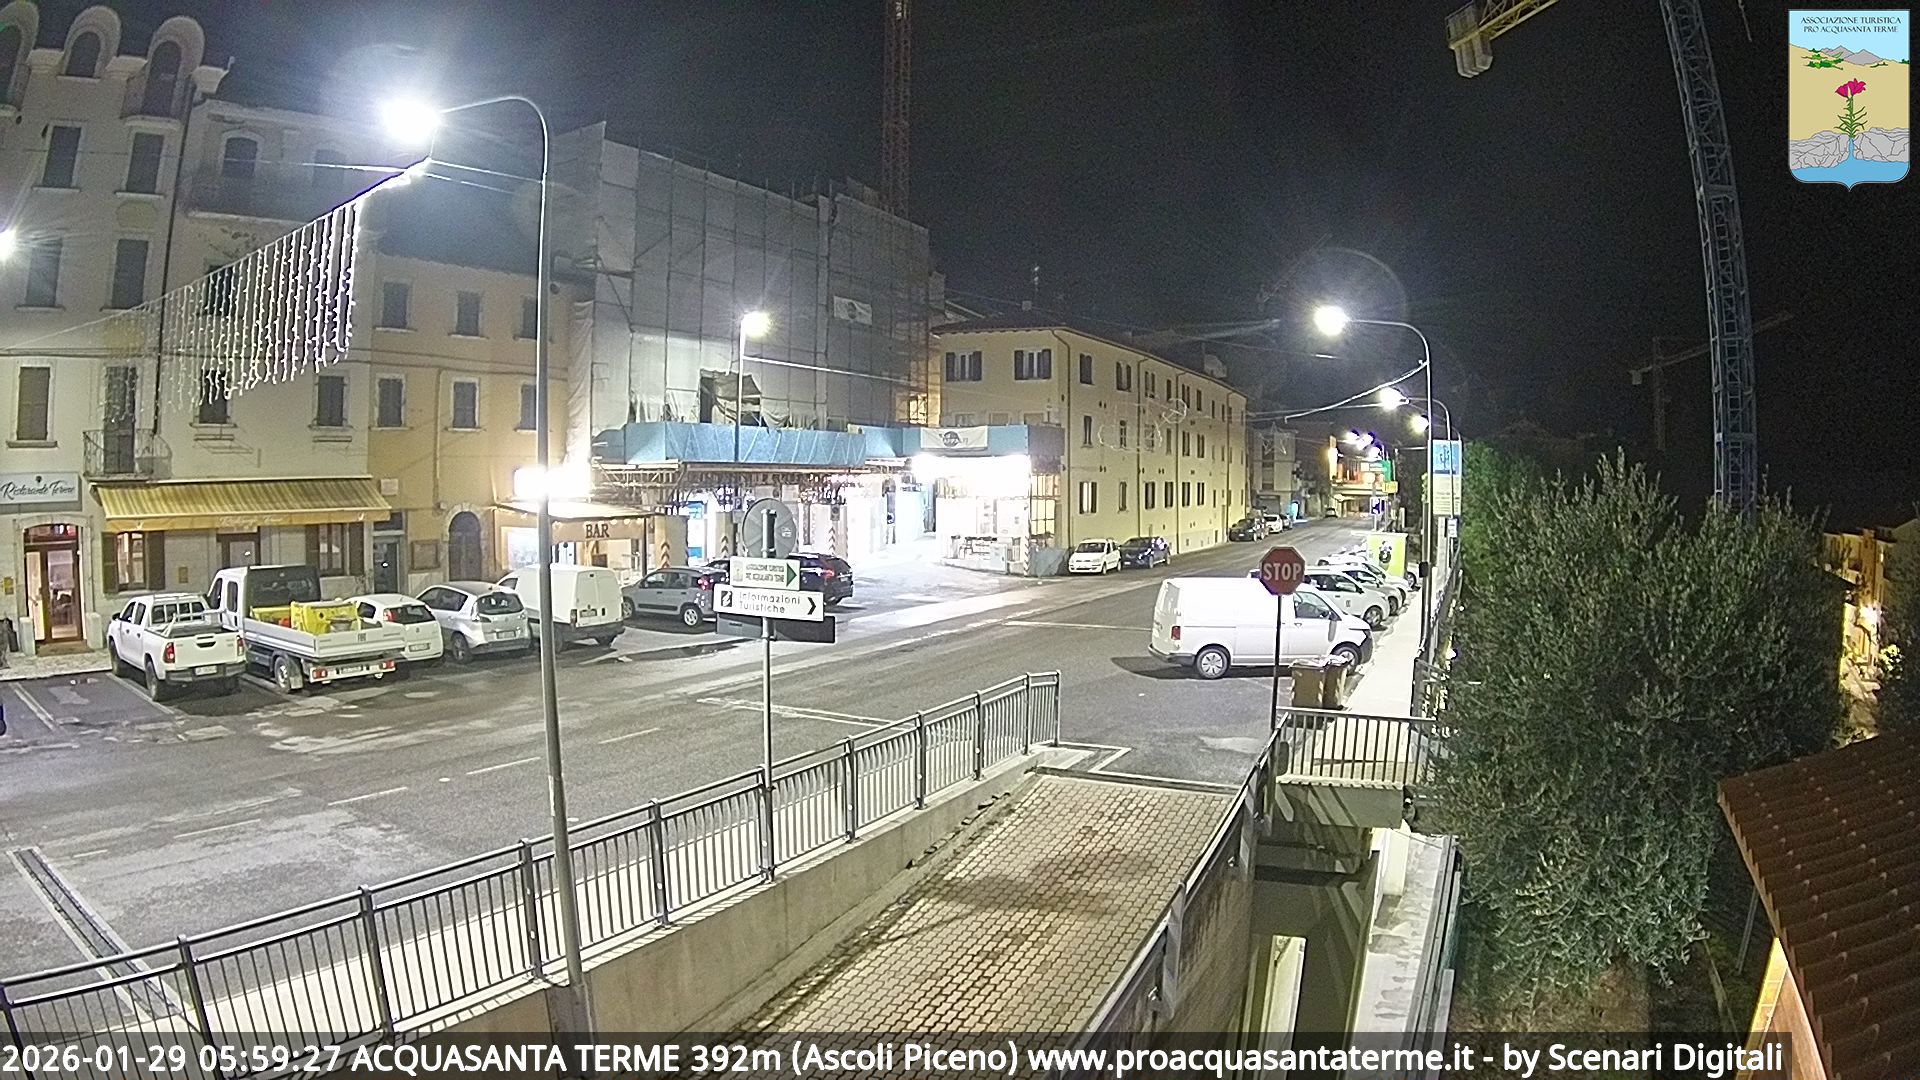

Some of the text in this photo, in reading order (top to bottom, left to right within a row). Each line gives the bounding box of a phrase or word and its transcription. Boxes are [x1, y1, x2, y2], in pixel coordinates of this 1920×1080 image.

[585, 523, 610, 539] BAR
[1263, 562, 1302, 581] STOP
[739, 591, 801, 605] Informazioni
[739, 600, 786, 614] Turistiche
